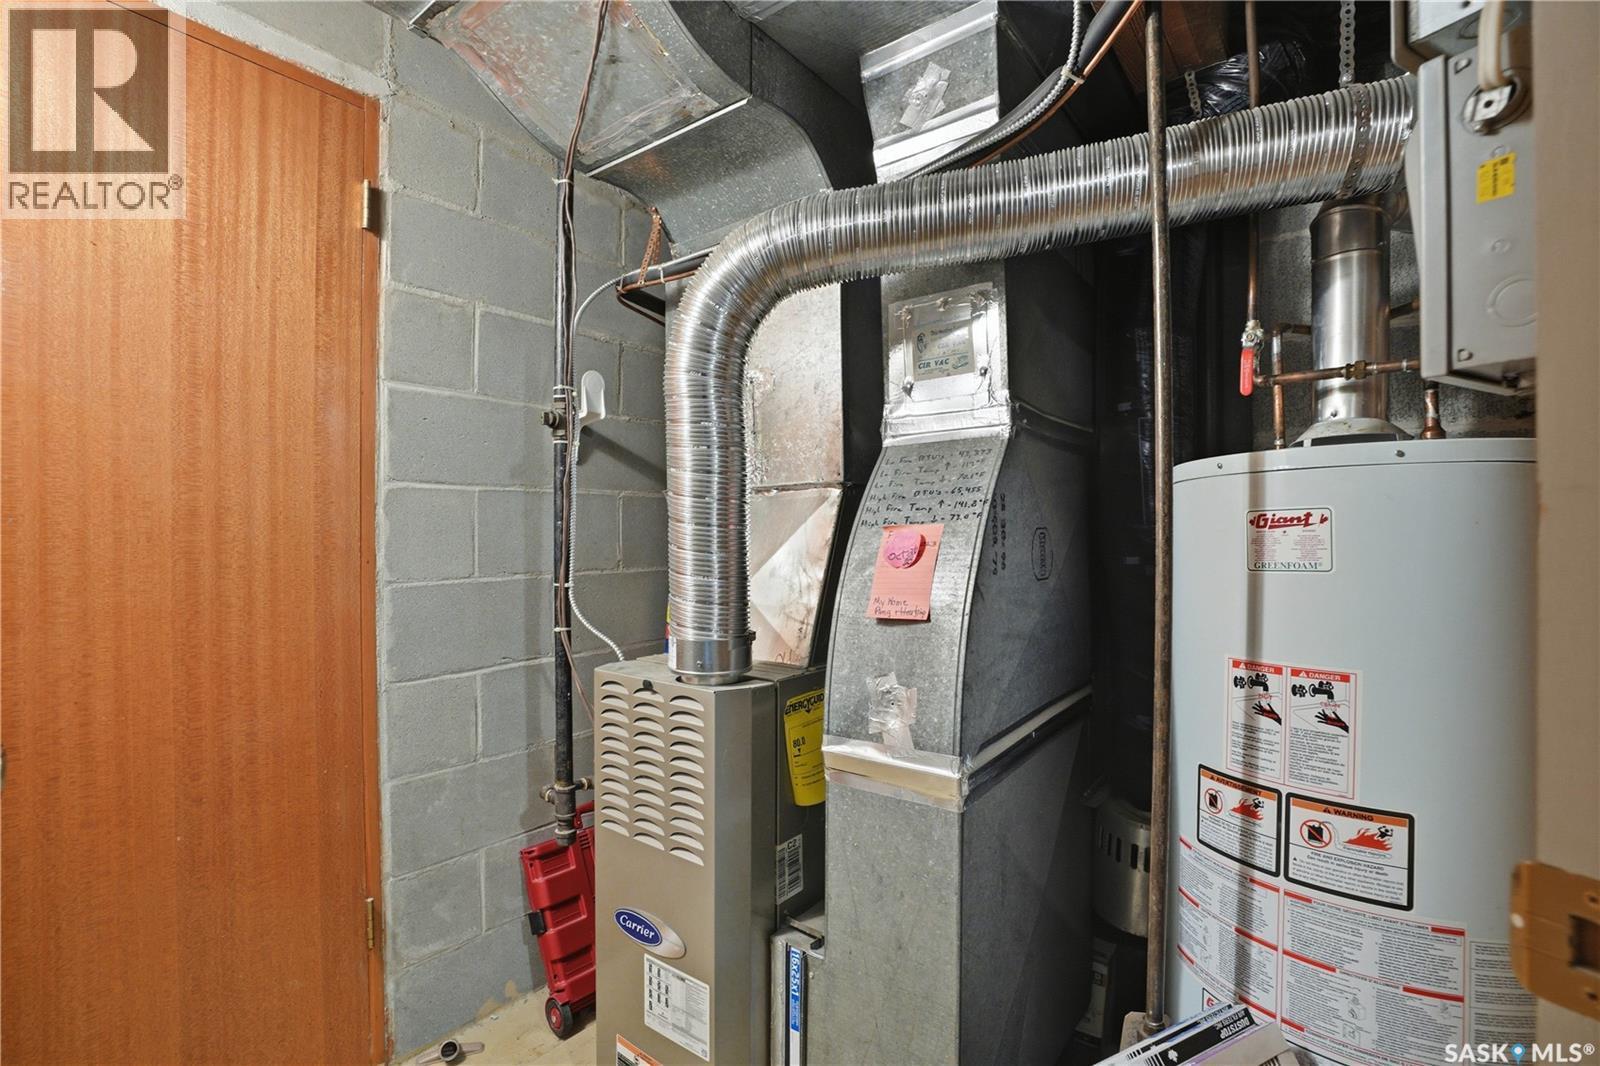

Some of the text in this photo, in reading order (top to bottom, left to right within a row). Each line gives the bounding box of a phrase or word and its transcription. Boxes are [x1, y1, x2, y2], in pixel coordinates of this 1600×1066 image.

[1255, 512, 1314, 529] Giant
[1308, 672, 1342, 681] DANGER
[1334, 808, 1374, 822] WARNING
[619, 914, 655, 939] Carrier
[1219, 1017, 1250, 1039] DUSTSTOP
